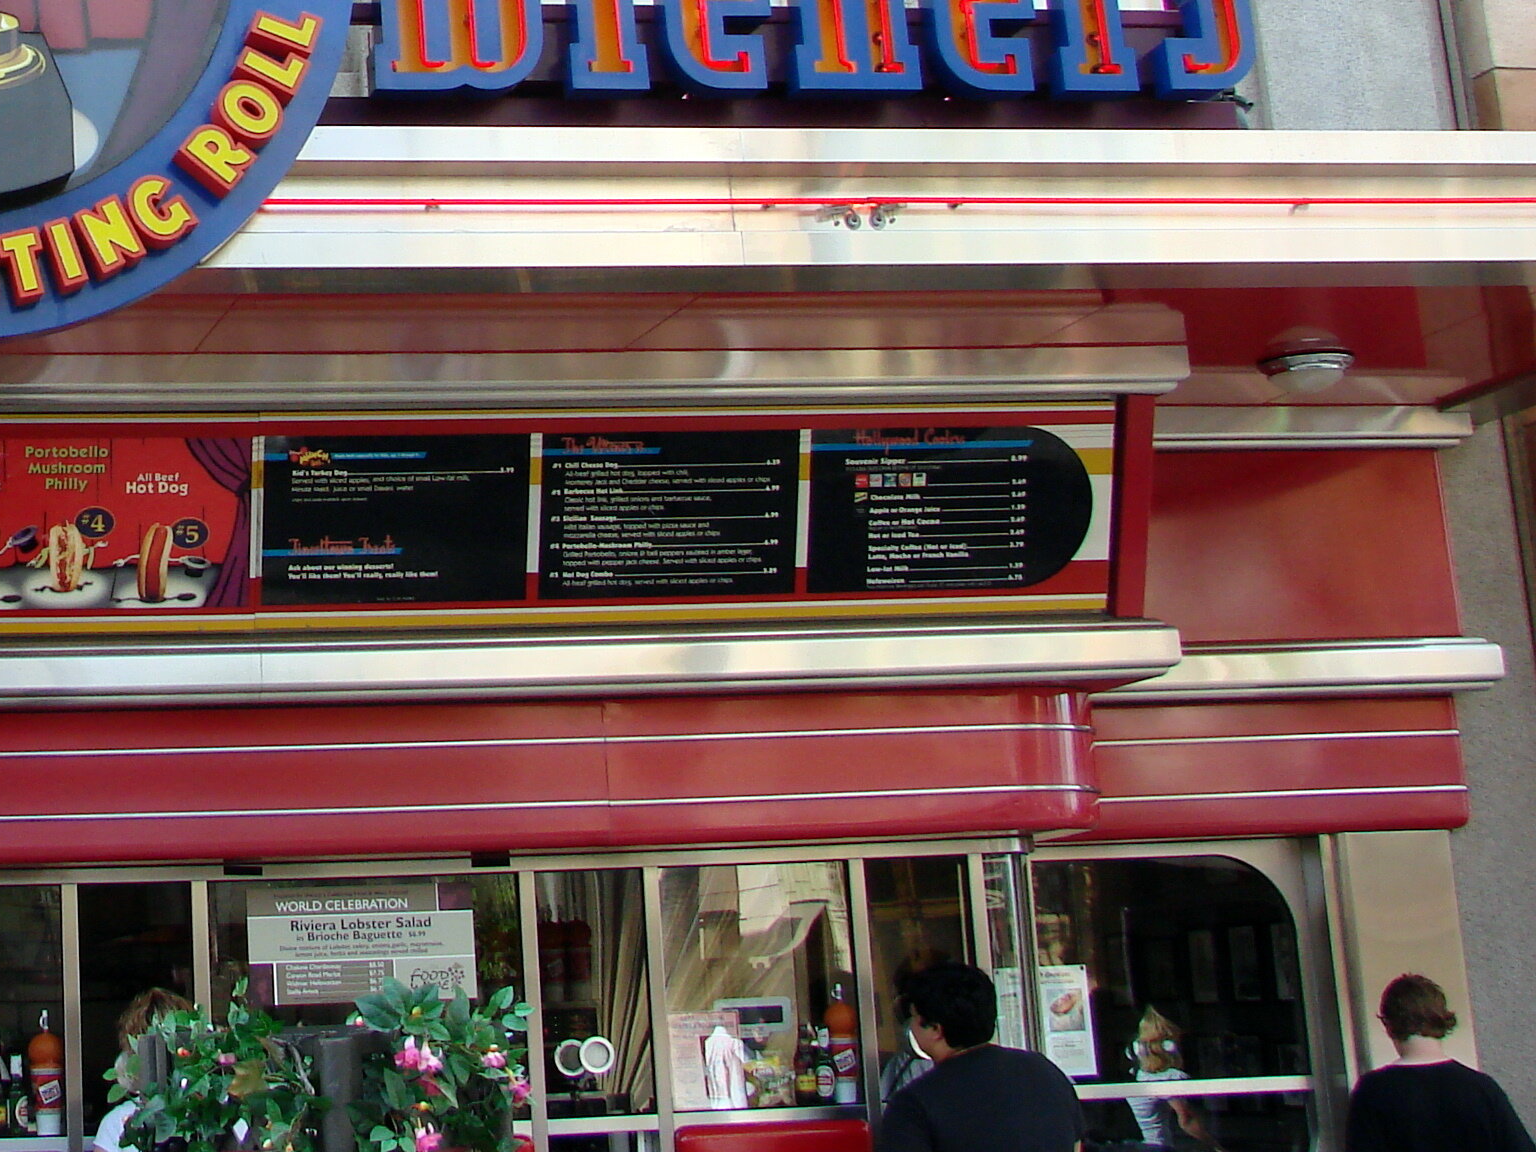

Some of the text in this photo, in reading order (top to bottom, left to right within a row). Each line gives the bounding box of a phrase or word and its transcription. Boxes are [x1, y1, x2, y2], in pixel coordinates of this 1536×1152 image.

[173, 9, 327, 199] ROLL
[24, 445, 109, 458] Portobello
[28, 461, 106, 474] Mushroom
[45, 477, 88, 492] Philly
[136, 472, 180, 482] All Beef
[125, 481, 189, 496] Hot Dog
[80, 513, 106, 533] #4
[175, 523, 200, 543] #5
[275, 898, 408, 913] WORLD CELEBRATION
[290, 916, 432, 932] Riviera Lobster Salad
[306, 932, 350, 942] Brioche
[352, 930, 403, 943] Baguette
[410, 967, 450, 980] FOOD
